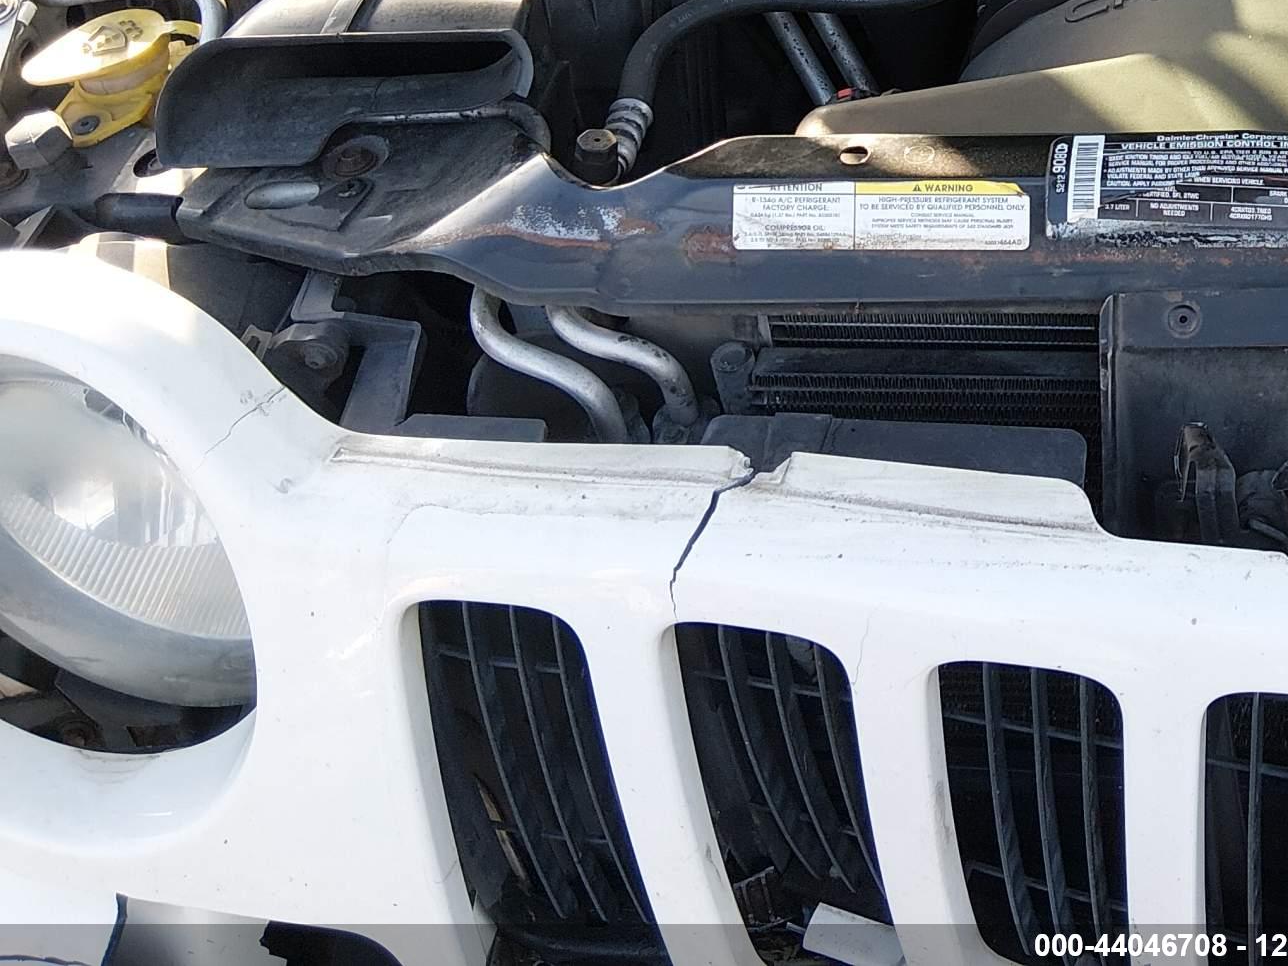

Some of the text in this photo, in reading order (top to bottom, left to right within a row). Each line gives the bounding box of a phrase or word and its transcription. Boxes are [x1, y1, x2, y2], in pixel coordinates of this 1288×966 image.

[1157, 134, 1239, 142] DaimlerChrysler
[1121, 142, 1165, 150] VEHICLE
[1169, 141, 1223, 149] EMISSION
[1227, 140, 1279, 148] CONTROL
[770, 183, 823, 192] ATTENTION
[925, 184, 973, 192] WARNING
